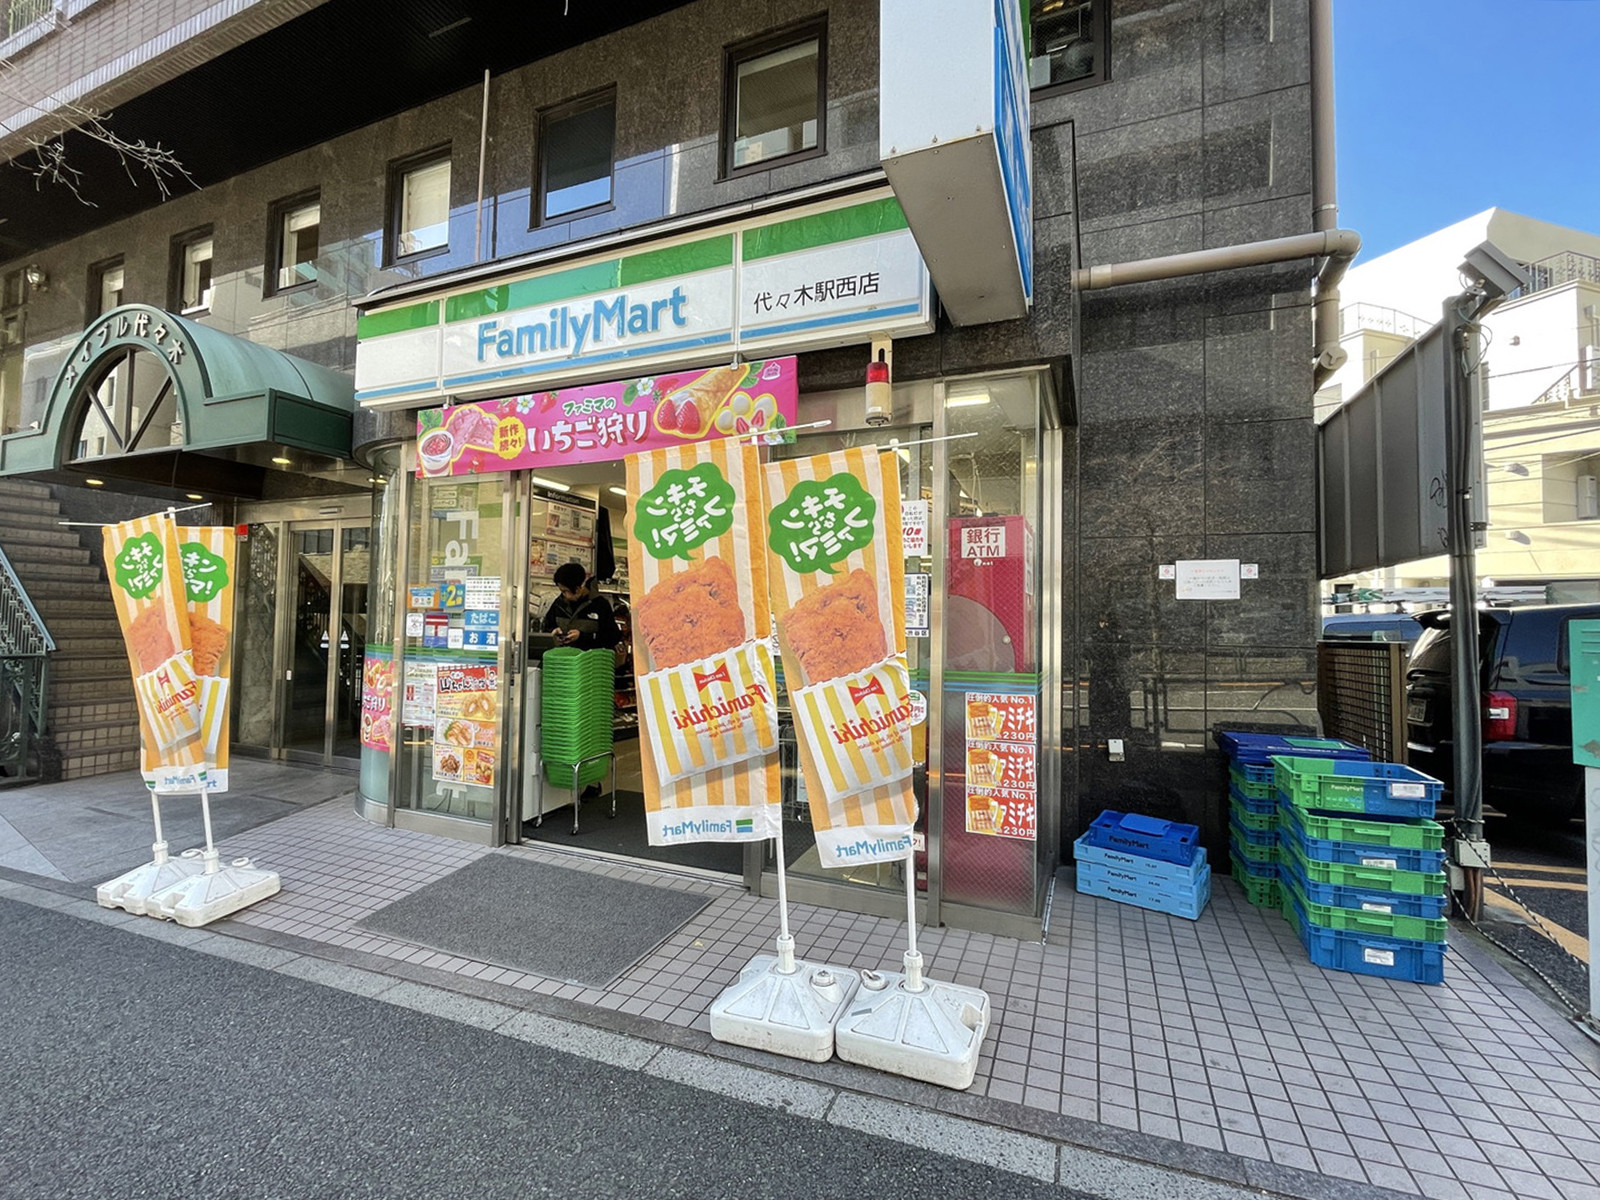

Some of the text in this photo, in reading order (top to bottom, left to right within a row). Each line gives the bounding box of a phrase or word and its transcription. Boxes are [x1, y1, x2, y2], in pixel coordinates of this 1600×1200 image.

[753, 272, 880, 314] 代々木駅西店
[477, 285, 687, 362] FamilyMart
[563, 397, 616, 416] ファミマの
[499, 424, 519, 438] 新作
[527, 411, 650, 454] いちご狩り
[966, 528, 1001, 544] 銀行
[966, 545, 1000, 557] ATM
[180, 548, 218, 574] キン
[470, 612, 497, 624] たばこ
[469, 632, 497, 644] お酒
[1010, 695, 1033, 705] No.1
[990, 706, 1034, 732] ファミチキ
[1002, 731, 1034, 740] 230円
[1010, 744, 1033, 755] No.1
[989, 753, 1034, 780] ファミチキ
[1002, 779, 1035, 790] 230円
[1011, 791, 1034, 801] No.1
[989, 800, 1035, 829] ファミチキ
[1003, 826, 1035, 838] 230円
[1108, 835, 1150, 849] FamilyMart
[1104, 853, 1134, 864] FamilyMart
[1107, 870, 1137, 881] FamilyMart
[1107, 886, 1137, 898] FamilyMart
